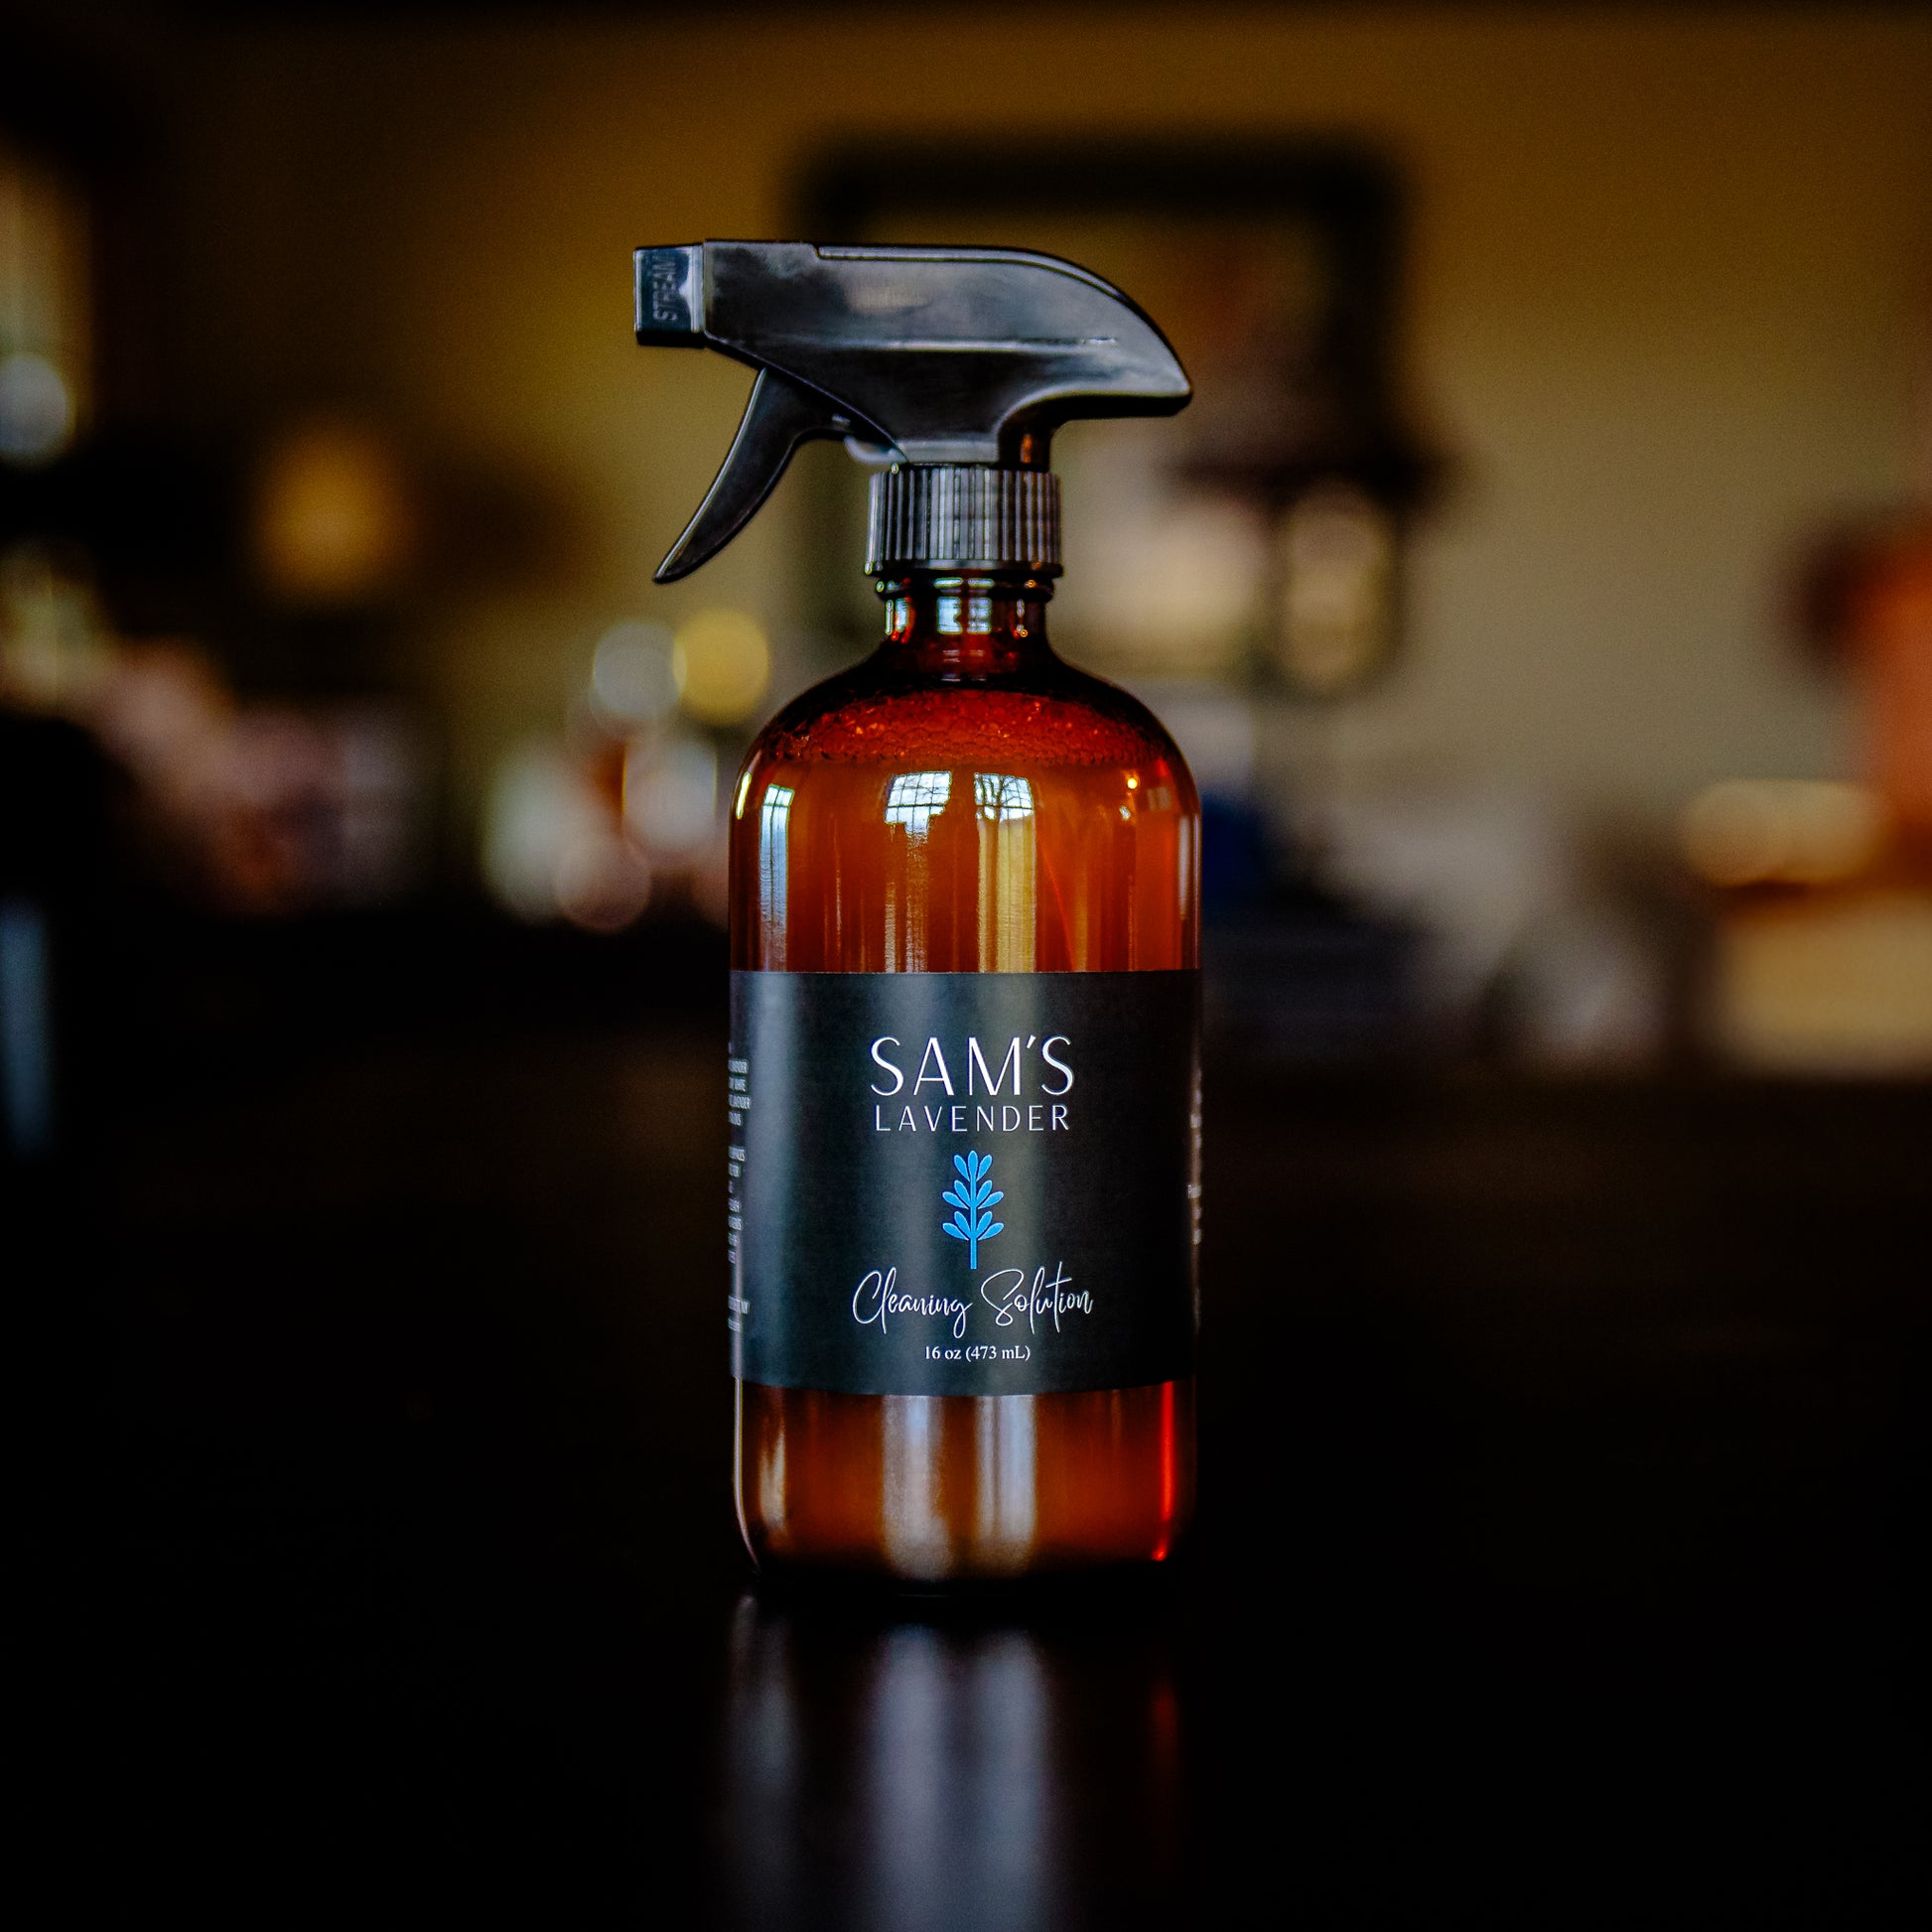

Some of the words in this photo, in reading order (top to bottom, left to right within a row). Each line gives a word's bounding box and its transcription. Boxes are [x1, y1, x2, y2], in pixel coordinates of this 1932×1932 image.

[652, 254, 677, 321] STREAM
[870, 1034, 1075, 1096] SAM'S
[875, 1104, 1070, 1132] LAVENDER
[852, 1266, 974, 1339] Cleaning
[980, 1260, 1095, 1335] Solution
[924, 1345, 941, 1360] 16
[944, 1349, 962, 1360] oz
[965, 1345, 997, 1362] (473
[1001, 1345, 1032, 1362] mL)
